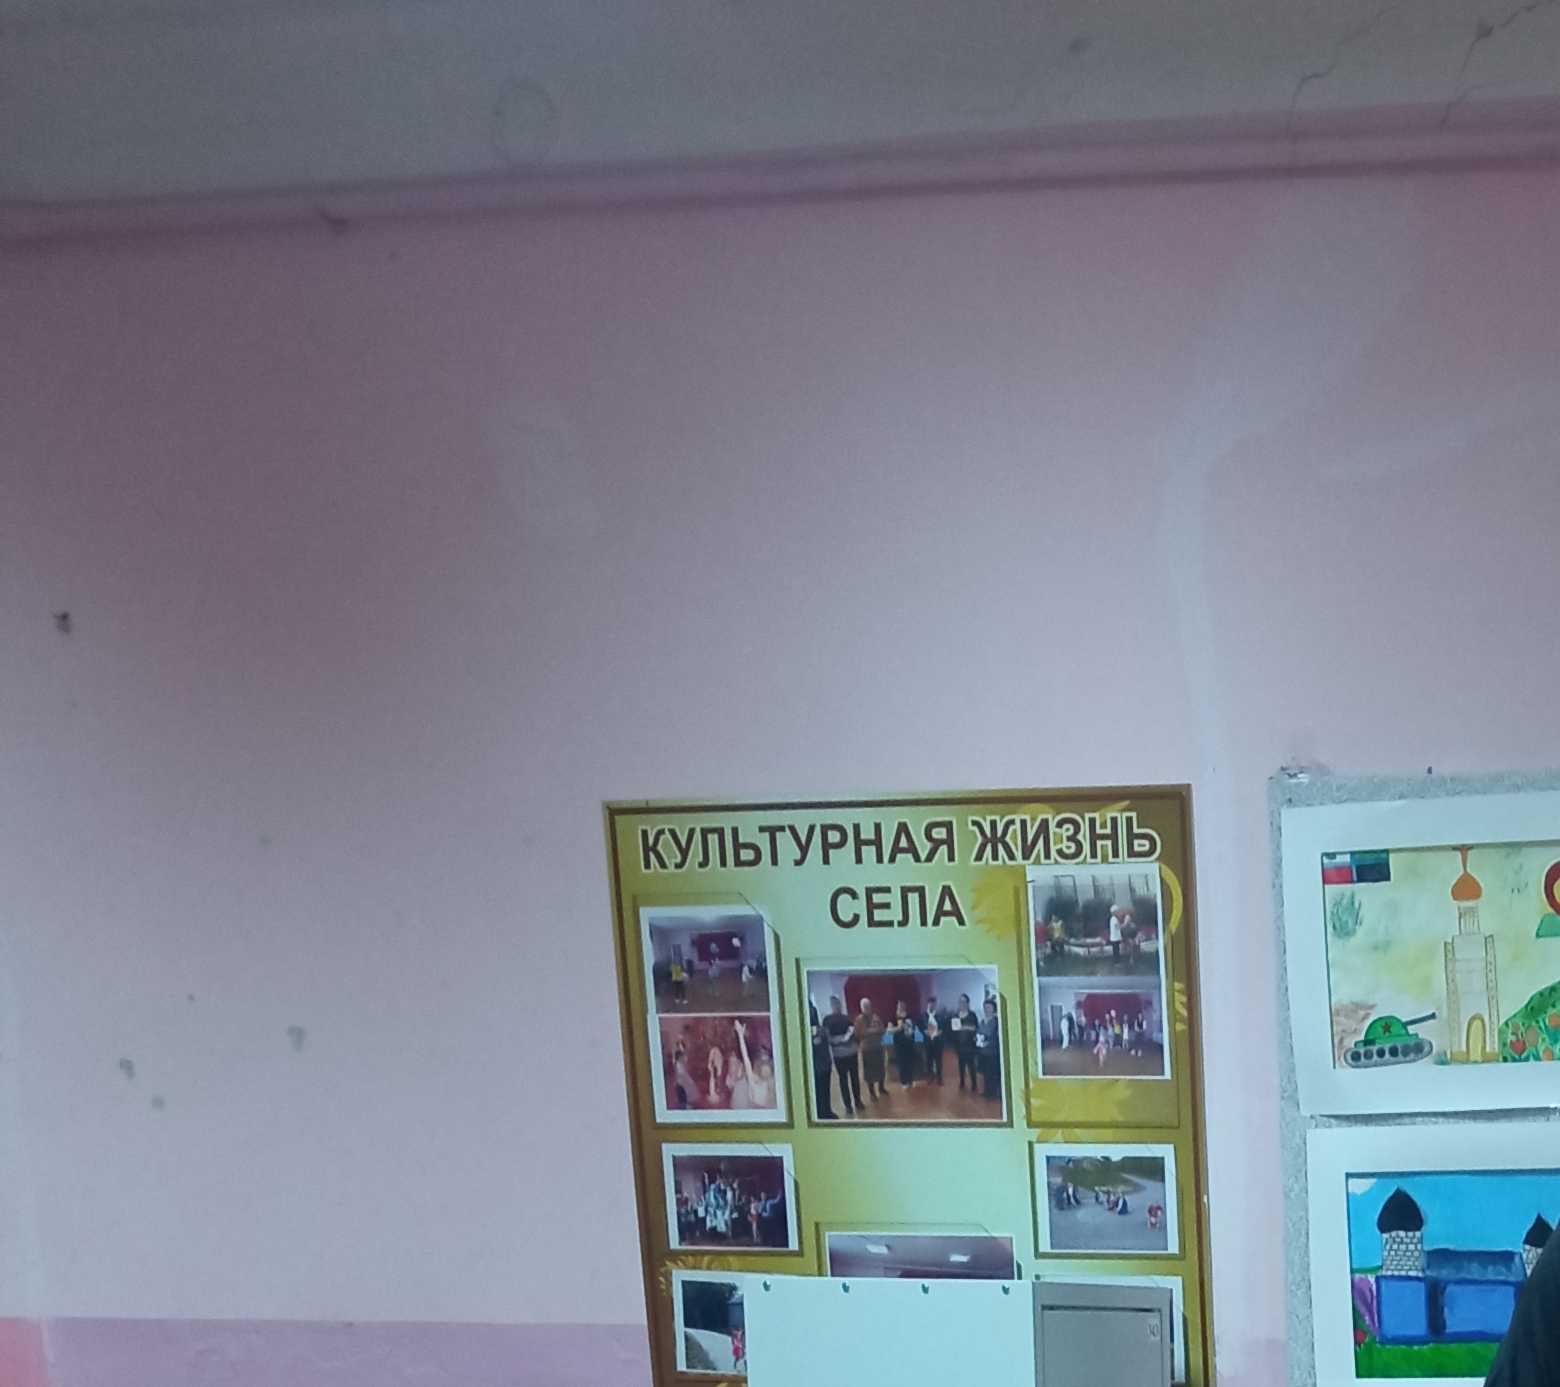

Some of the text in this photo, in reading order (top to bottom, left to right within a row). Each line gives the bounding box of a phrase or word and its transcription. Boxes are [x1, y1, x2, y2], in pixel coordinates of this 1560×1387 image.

[640, 814, 1160, 869] КУЛЬТУРНАЯ ЖИЗНЬ
[829, 884, 966, 929] СЕЛА
